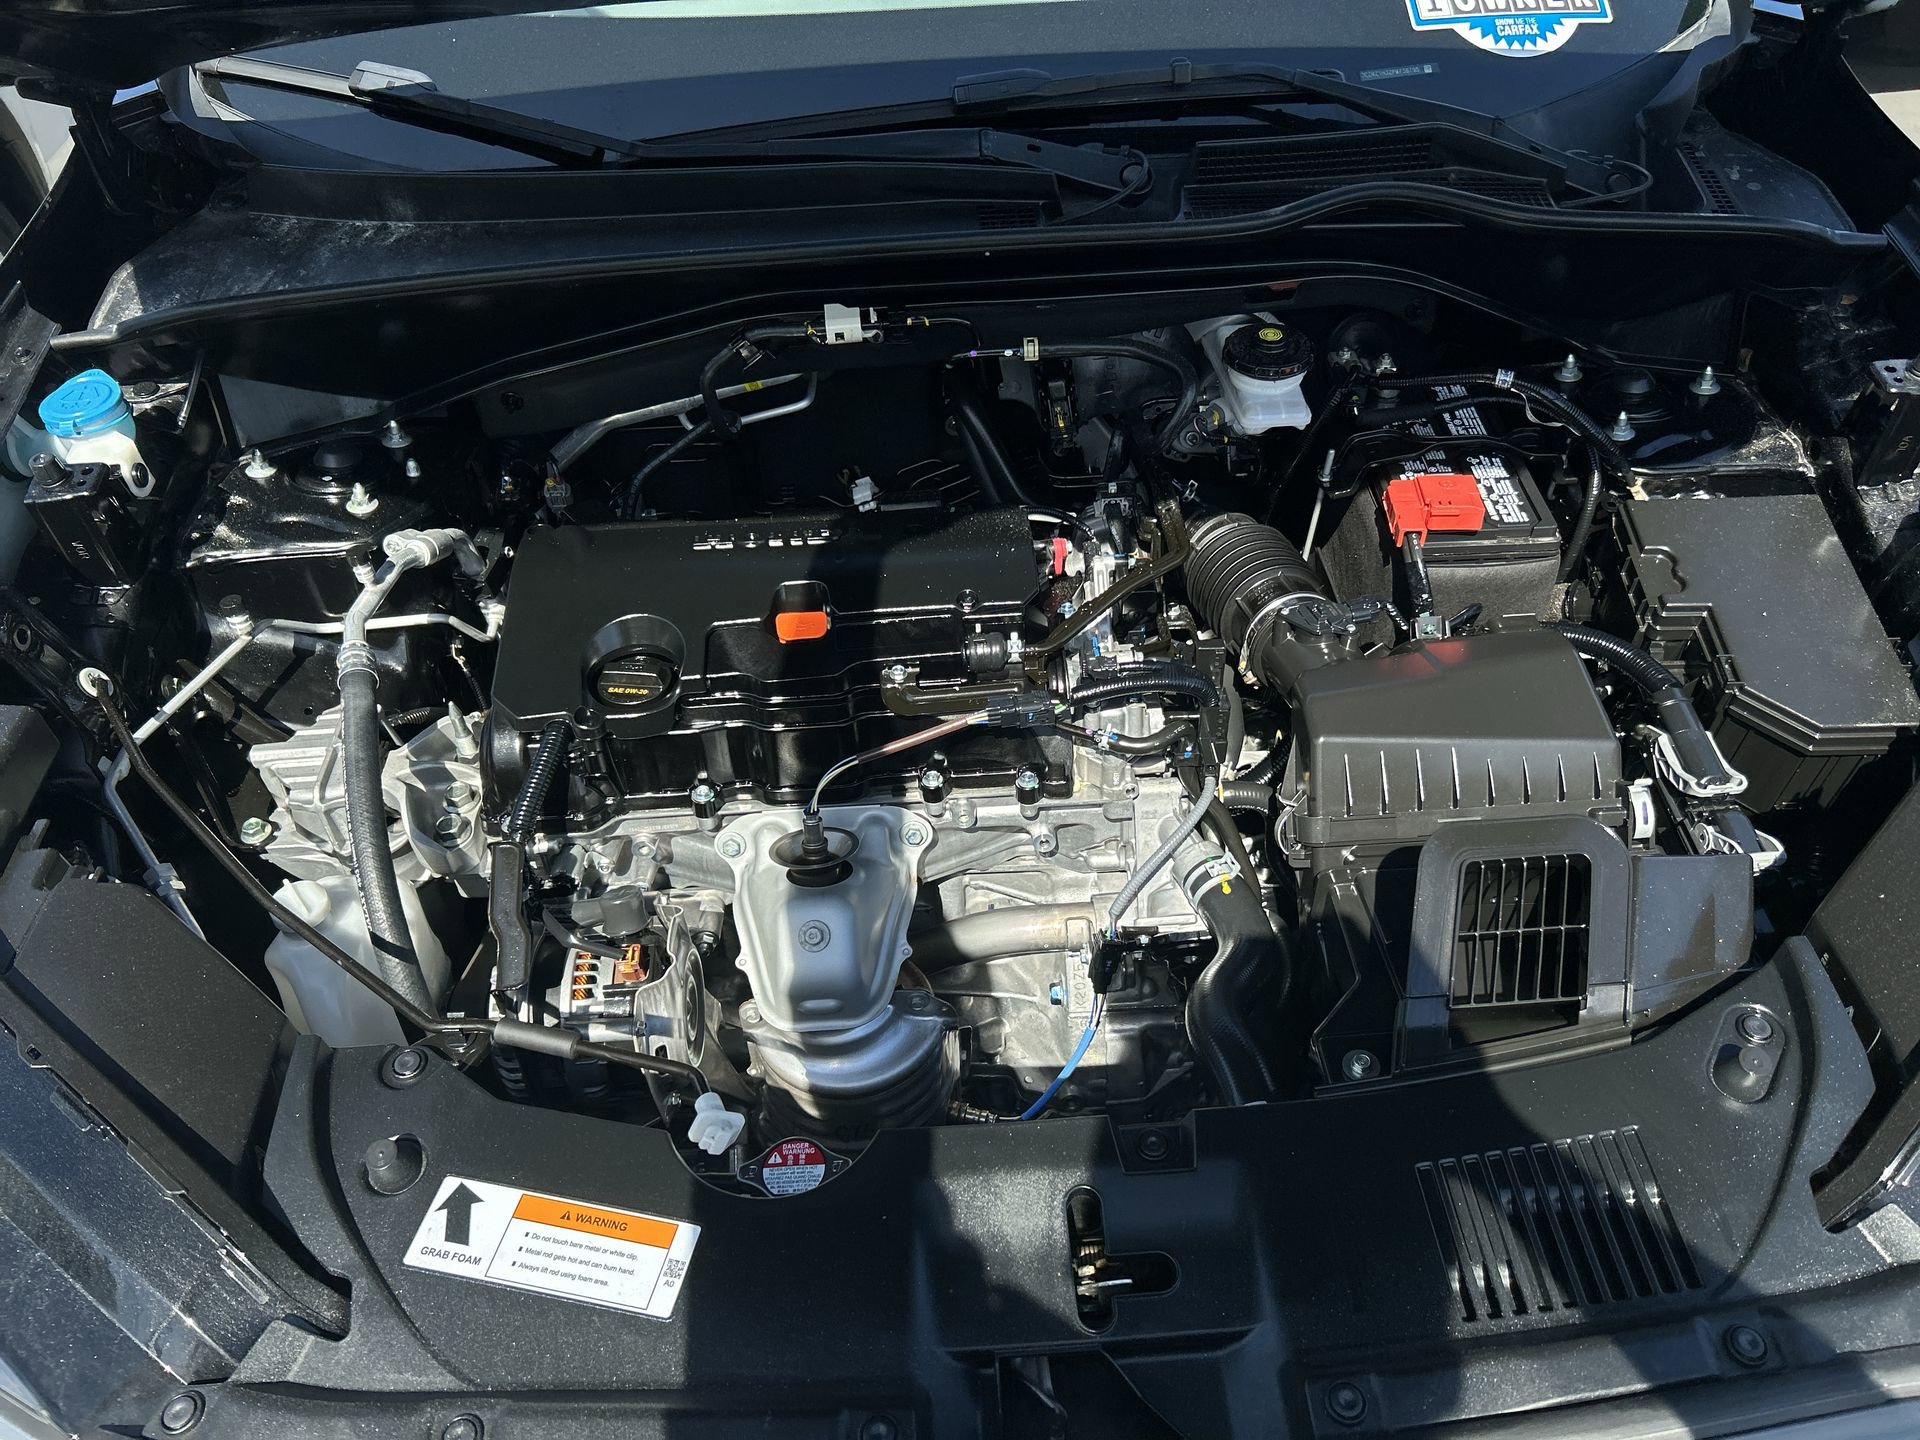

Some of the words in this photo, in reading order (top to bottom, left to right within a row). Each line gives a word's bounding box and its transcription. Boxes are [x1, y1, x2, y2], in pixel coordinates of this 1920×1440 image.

[1497, 24, 1540, 36] CARFAX
[576, 1213, 628, 1231] WARNING
[421, 1246, 450, 1259] GRAB
[451, 1252, 482, 1266] FOAM
[552, 1237, 569, 1246] touch
[569, 1240, 583, 1249] bare
[584, 1244, 602, 1252] metal
[609, 1249, 626, 1258] white
[626, 1252, 638, 1261] clip.
[525, 1247, 542, 1256] Metal
[603, 1263, 617, 1272] burn
[618, 1267, 635, 1276] hand.
[518, 1262, 540, 1272] Always
[541, 1266, 549, 1274] lift
[560, 1271, 577, 1280] using
[578, 1274, 593, 1283] foam
